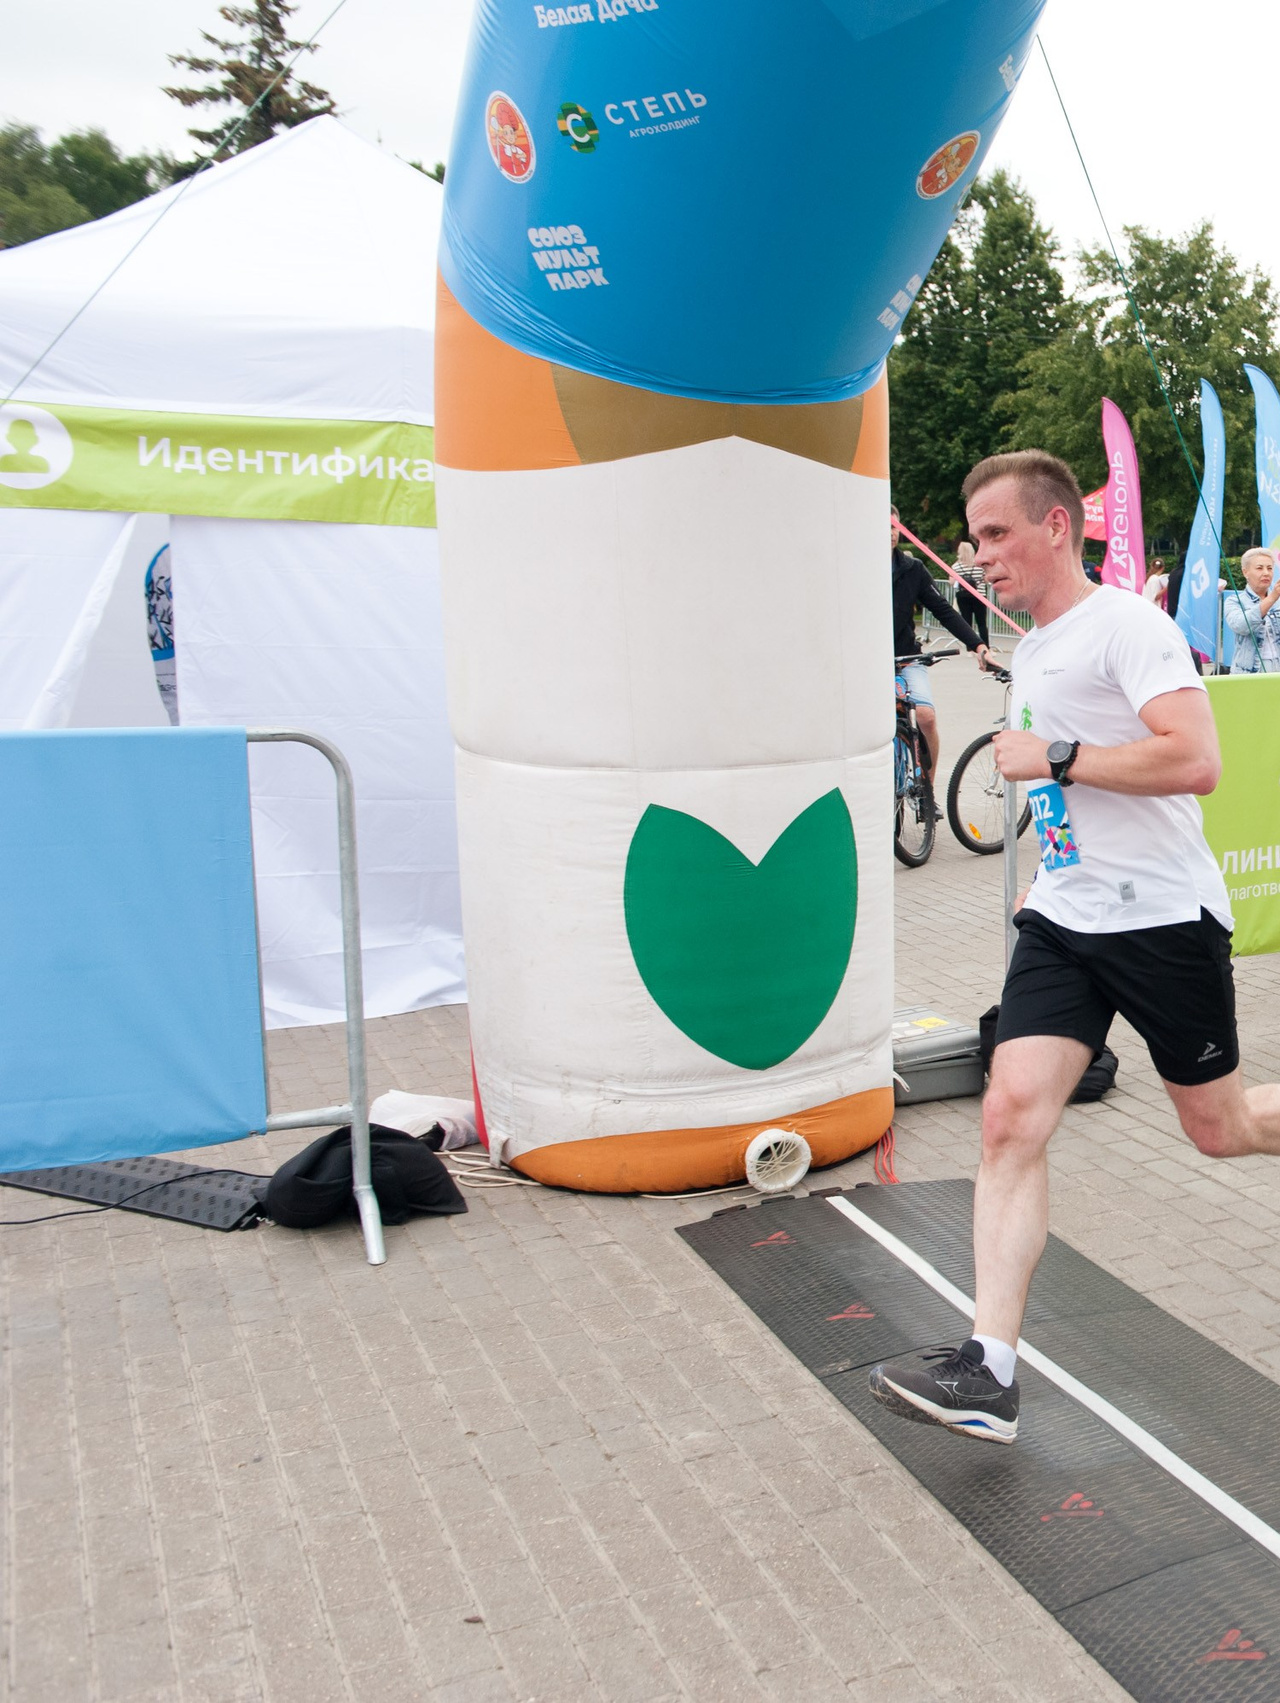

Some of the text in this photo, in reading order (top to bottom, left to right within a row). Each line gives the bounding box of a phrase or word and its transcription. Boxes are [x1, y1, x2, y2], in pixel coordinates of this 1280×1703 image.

[533, 4, 595, 28] Белая
[604, 88, 708, 125] СТЕПЬ
[629, 115, 701, 139] АГРОХОЛДИНГ
[527, 224, 588, 248] СОЮЗ
[531, 245, 602, 271] МУЛЬТ
[545, 267, 610, 292] ПАРК
[137, 435, 435, 484] Идентифика
[1197, 1049, 1223, 1063] DEMIX
